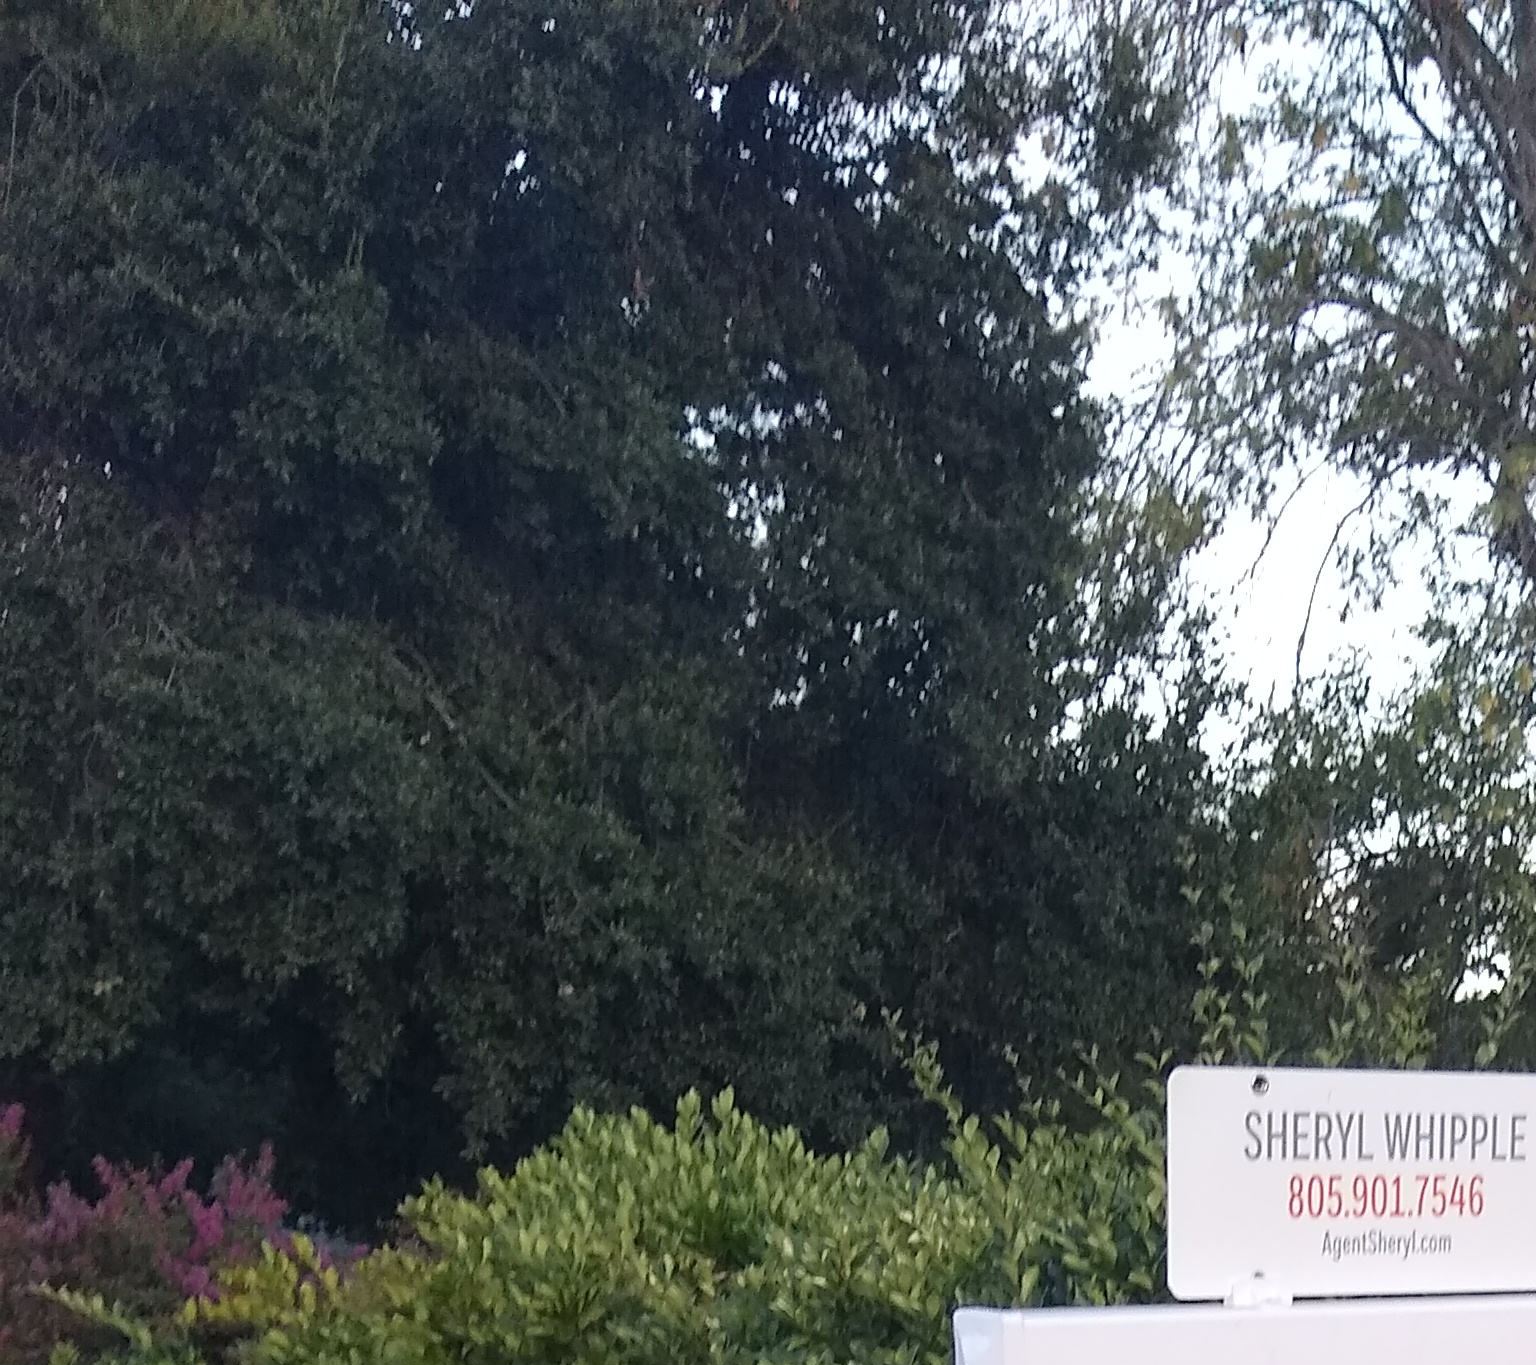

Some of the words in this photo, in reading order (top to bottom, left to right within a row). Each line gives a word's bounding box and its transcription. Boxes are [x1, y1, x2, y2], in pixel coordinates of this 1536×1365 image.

[1243, 1109, 1375, 1162] SHERYL
[1383, 1111, 1528, 1162] WHIPPLE
[1288, 1173, 1484, 1219] 805.901.7546
[1321, 1228, 1452, 1262] AgentSheryl.com
